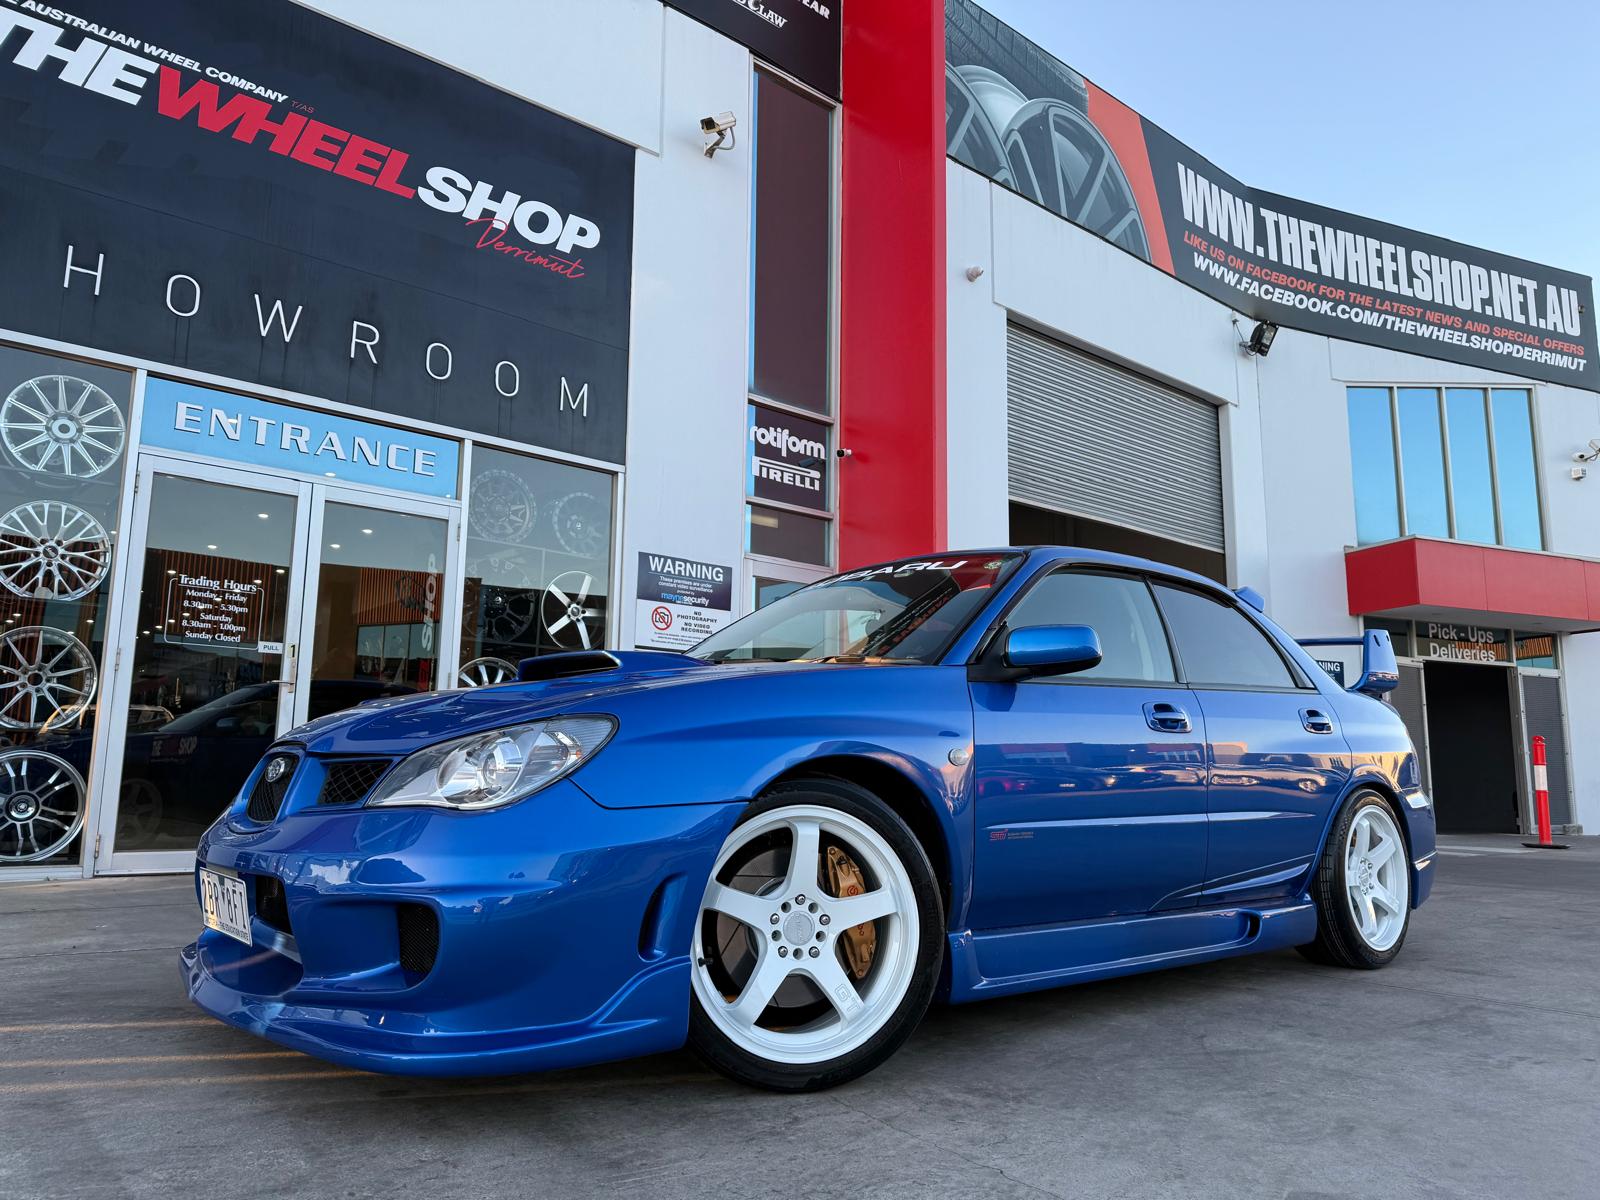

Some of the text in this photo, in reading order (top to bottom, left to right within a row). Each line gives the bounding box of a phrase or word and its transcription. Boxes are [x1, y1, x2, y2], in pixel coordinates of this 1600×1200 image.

[20, 0, 314, 114] AUSTRALIAN WHEEL COMPANY T/AS
[465, 217, 584, 279] Derrimut
[1177, 161, 1581, 337] WWW.THEWHEELSHOP.NET.AU
[1184, 231, 1585, 356] LIKE US ON FACEBOOK FOR THE LATEST NEWS AND SPECIAL OFFERS
[1193, 251, 1587, 372] WWW.FACEBOOK.COM/THEWHEELSHOPDERRIMUT
[174, 401, 438, 478] ENTRANCE
[750, 425, 826, 460] rotiform
[751, 455, 821, 491] PIRELLI
[648, 555, 724, 582] WARNING
[179, 574, 257, 592] Trading Hours
[183, 600, 212, 609] 8.30am
[220, 604, 248, 613] 5.30pm
[186, 589, 218, 600] Monday
[225, 594, 247, 603] Friday
[182, 620, 211, 629] 8.30am
[200, 613, 232, 623] Saturday
[676, 614, 718, 623] PHOTOGRAPHY
[185, 631, 240, 642] Sunday Closed
[680, 626, 713, 634] RECORDING
[1428, 623, 1458, 640] Pick
[1468, 626, 1494, 646] Ups
[1430, 642, 1496, 661] Deliveries
[1318, 660, 1341, 672] NING
